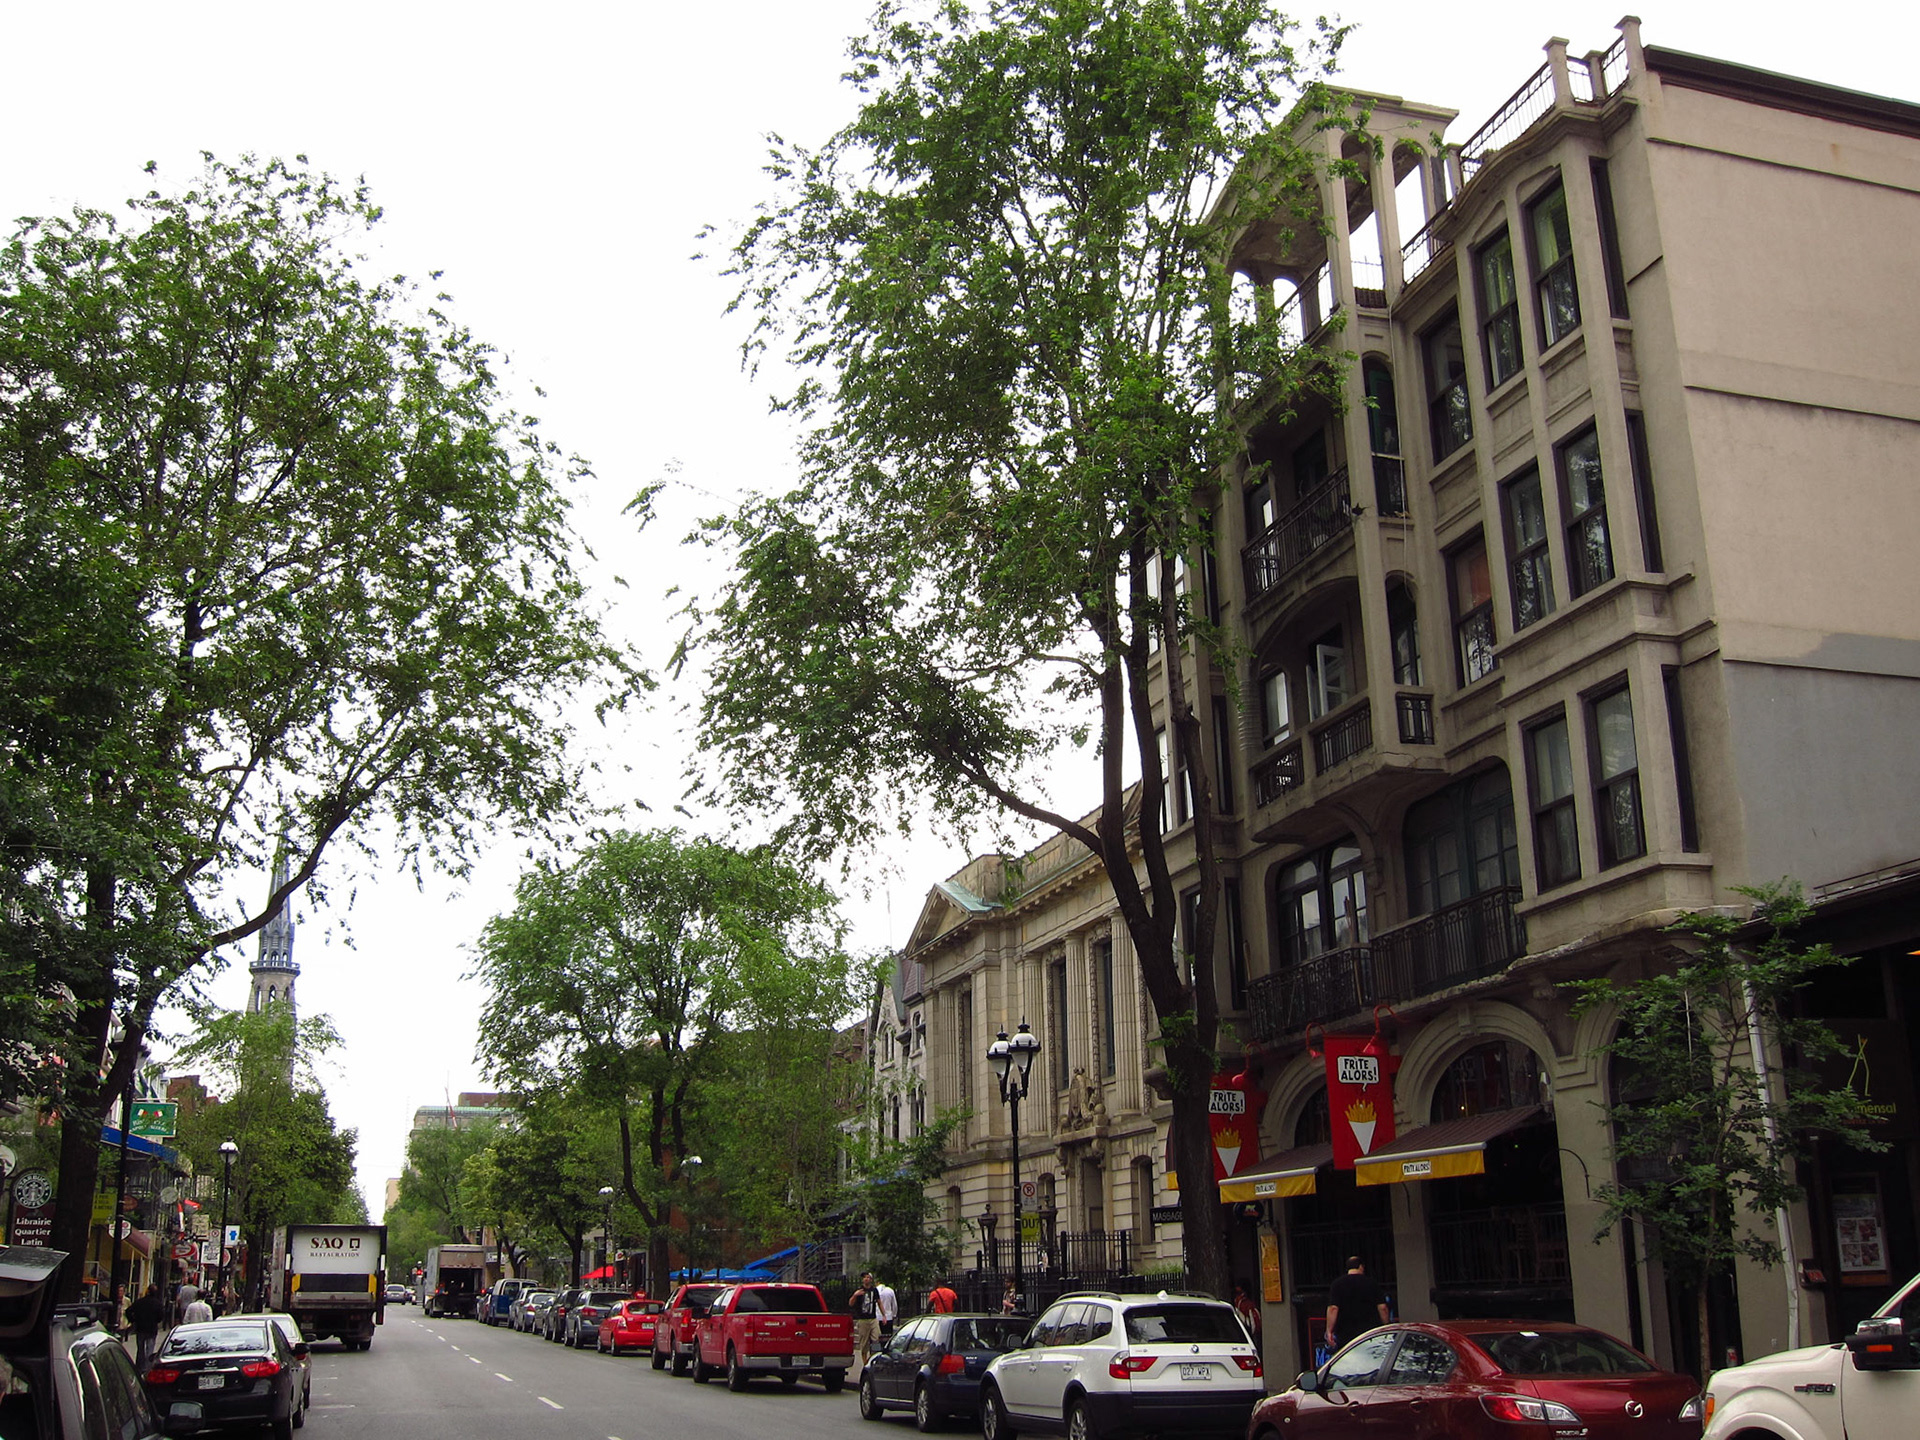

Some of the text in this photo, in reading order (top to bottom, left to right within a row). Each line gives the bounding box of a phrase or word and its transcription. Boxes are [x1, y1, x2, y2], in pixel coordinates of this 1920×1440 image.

[1344, 1058, 1369, 1070] FRITE
[1341, 1067, 1377, 1081] ALORS!
[1214, 1091, 1237, 1102] FRITE
[1210, 1099, 1244, 1112] ALORS!
[18, 1175, 50, 1190] STARBUCKS
[19, 1197, 45, 1207] COFFEE
[16, 1218, 52, 1226] Librairie
[1152, 1211, 1183, 1222] MASSAGE
[14, 1228, 51, 1237] Quartier
[21, 1238, 43, 1246] Latin
[310, 1237, 344, 1249] SAQ
